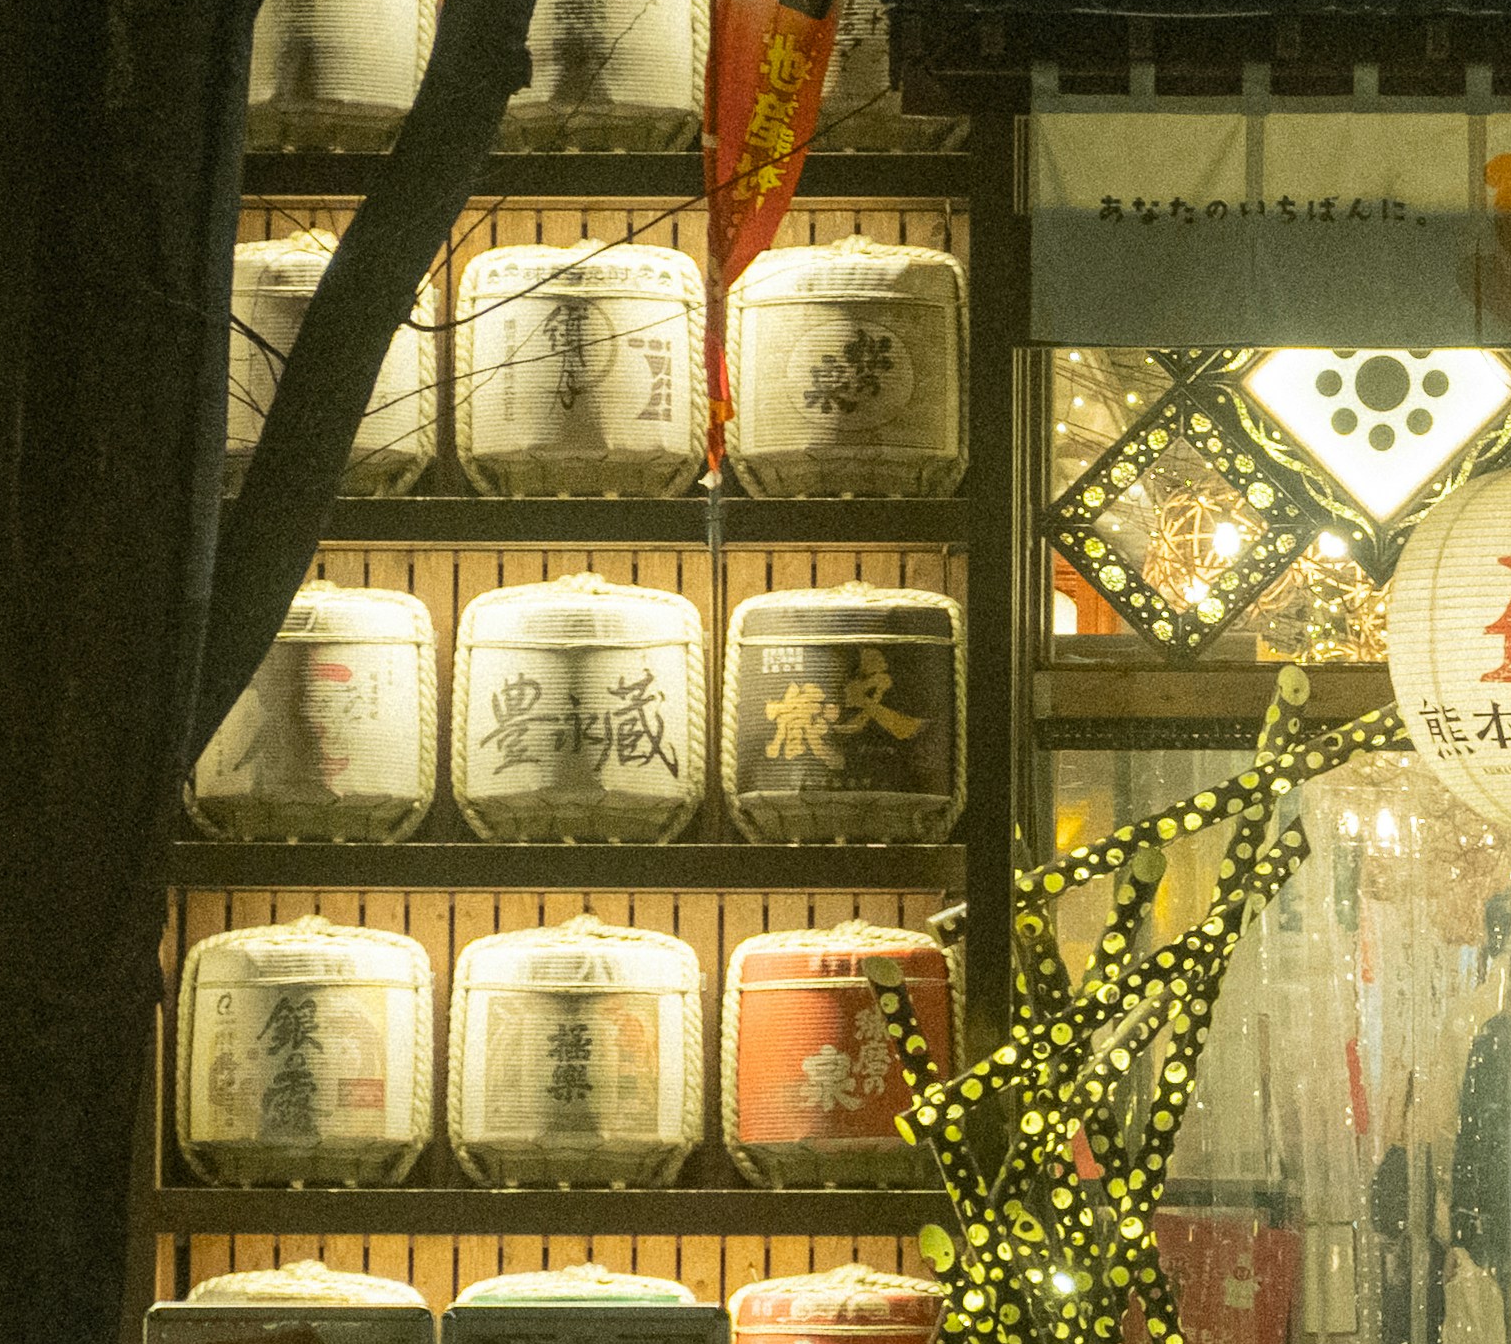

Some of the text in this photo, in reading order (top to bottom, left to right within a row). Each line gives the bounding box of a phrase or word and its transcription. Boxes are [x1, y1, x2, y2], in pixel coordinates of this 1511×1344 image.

[1098, 193, 1428, 228] あなたのいちばんに。
[480, 668, 679, 779] 豊永蔵
[545, 1022, 594, 1103] 極楽
